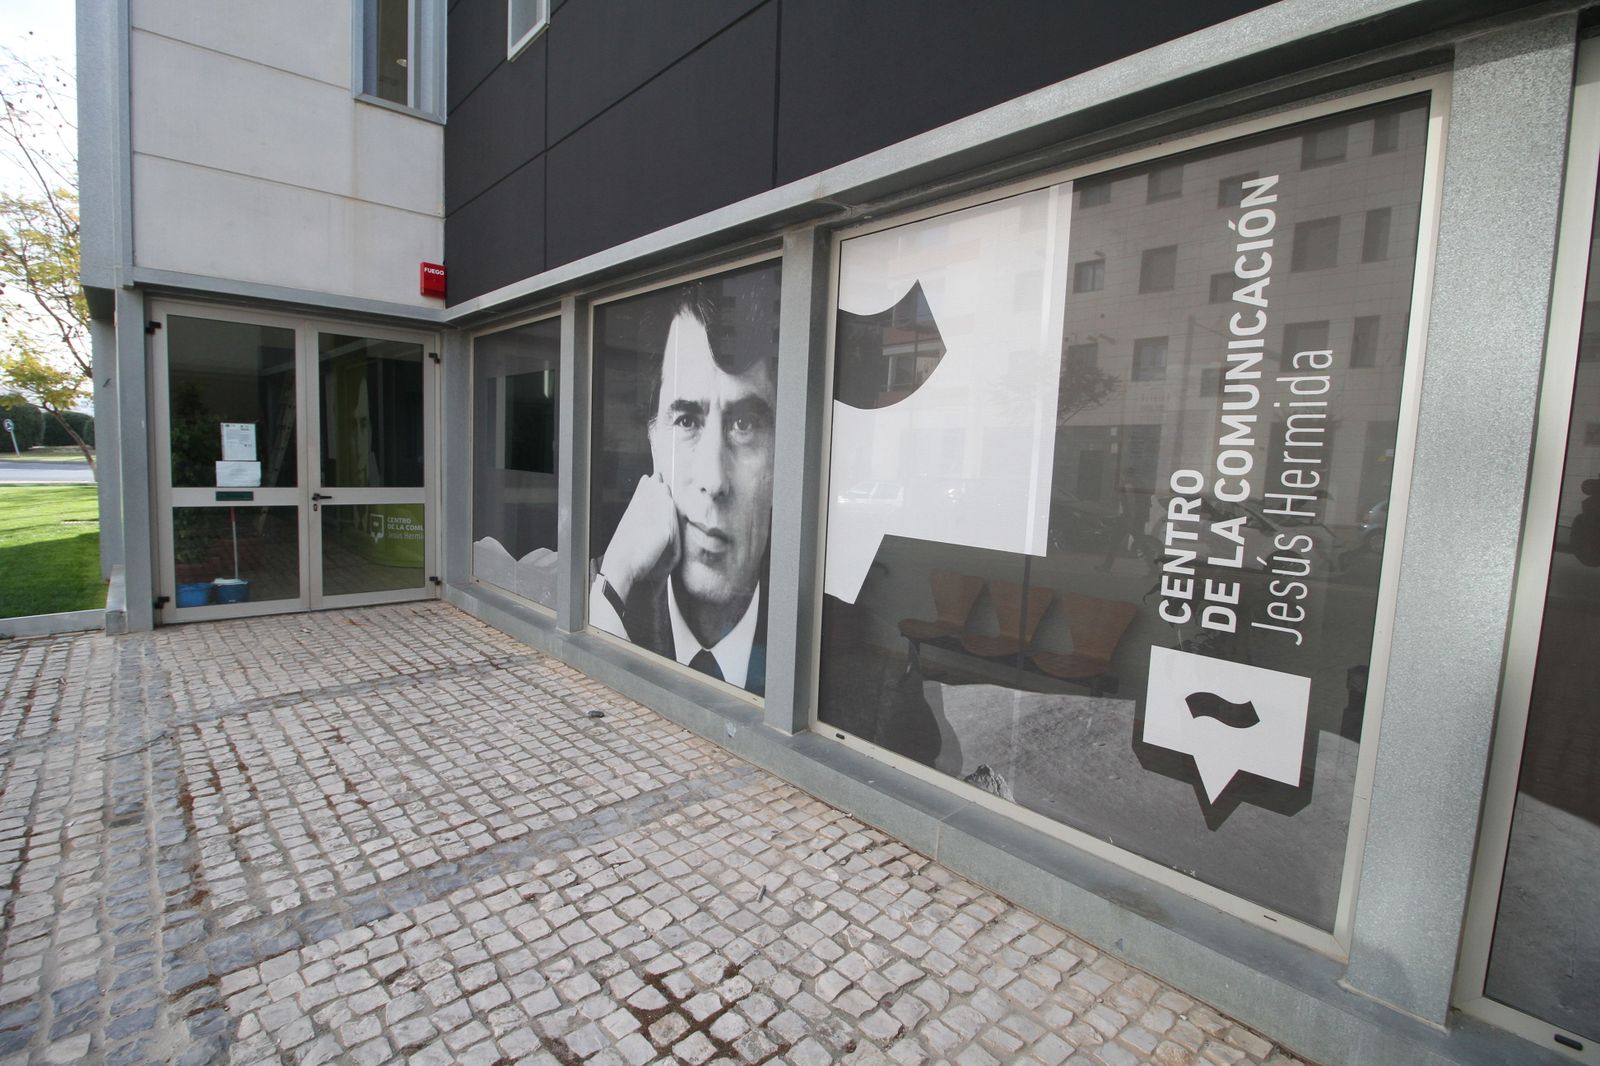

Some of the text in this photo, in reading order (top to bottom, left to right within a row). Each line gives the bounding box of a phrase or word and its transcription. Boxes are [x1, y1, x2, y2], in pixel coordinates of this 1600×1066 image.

[424, 266, 445, 276] FUEGO
[1202, 174, 1279, 633] DE LA COMUNICACIÓN
[387, 516, 412, 524] CENTRO
[1158, 469, 1205, 624] CENTRO
[1251, 349, 1334, 646] Jesús Hermida
